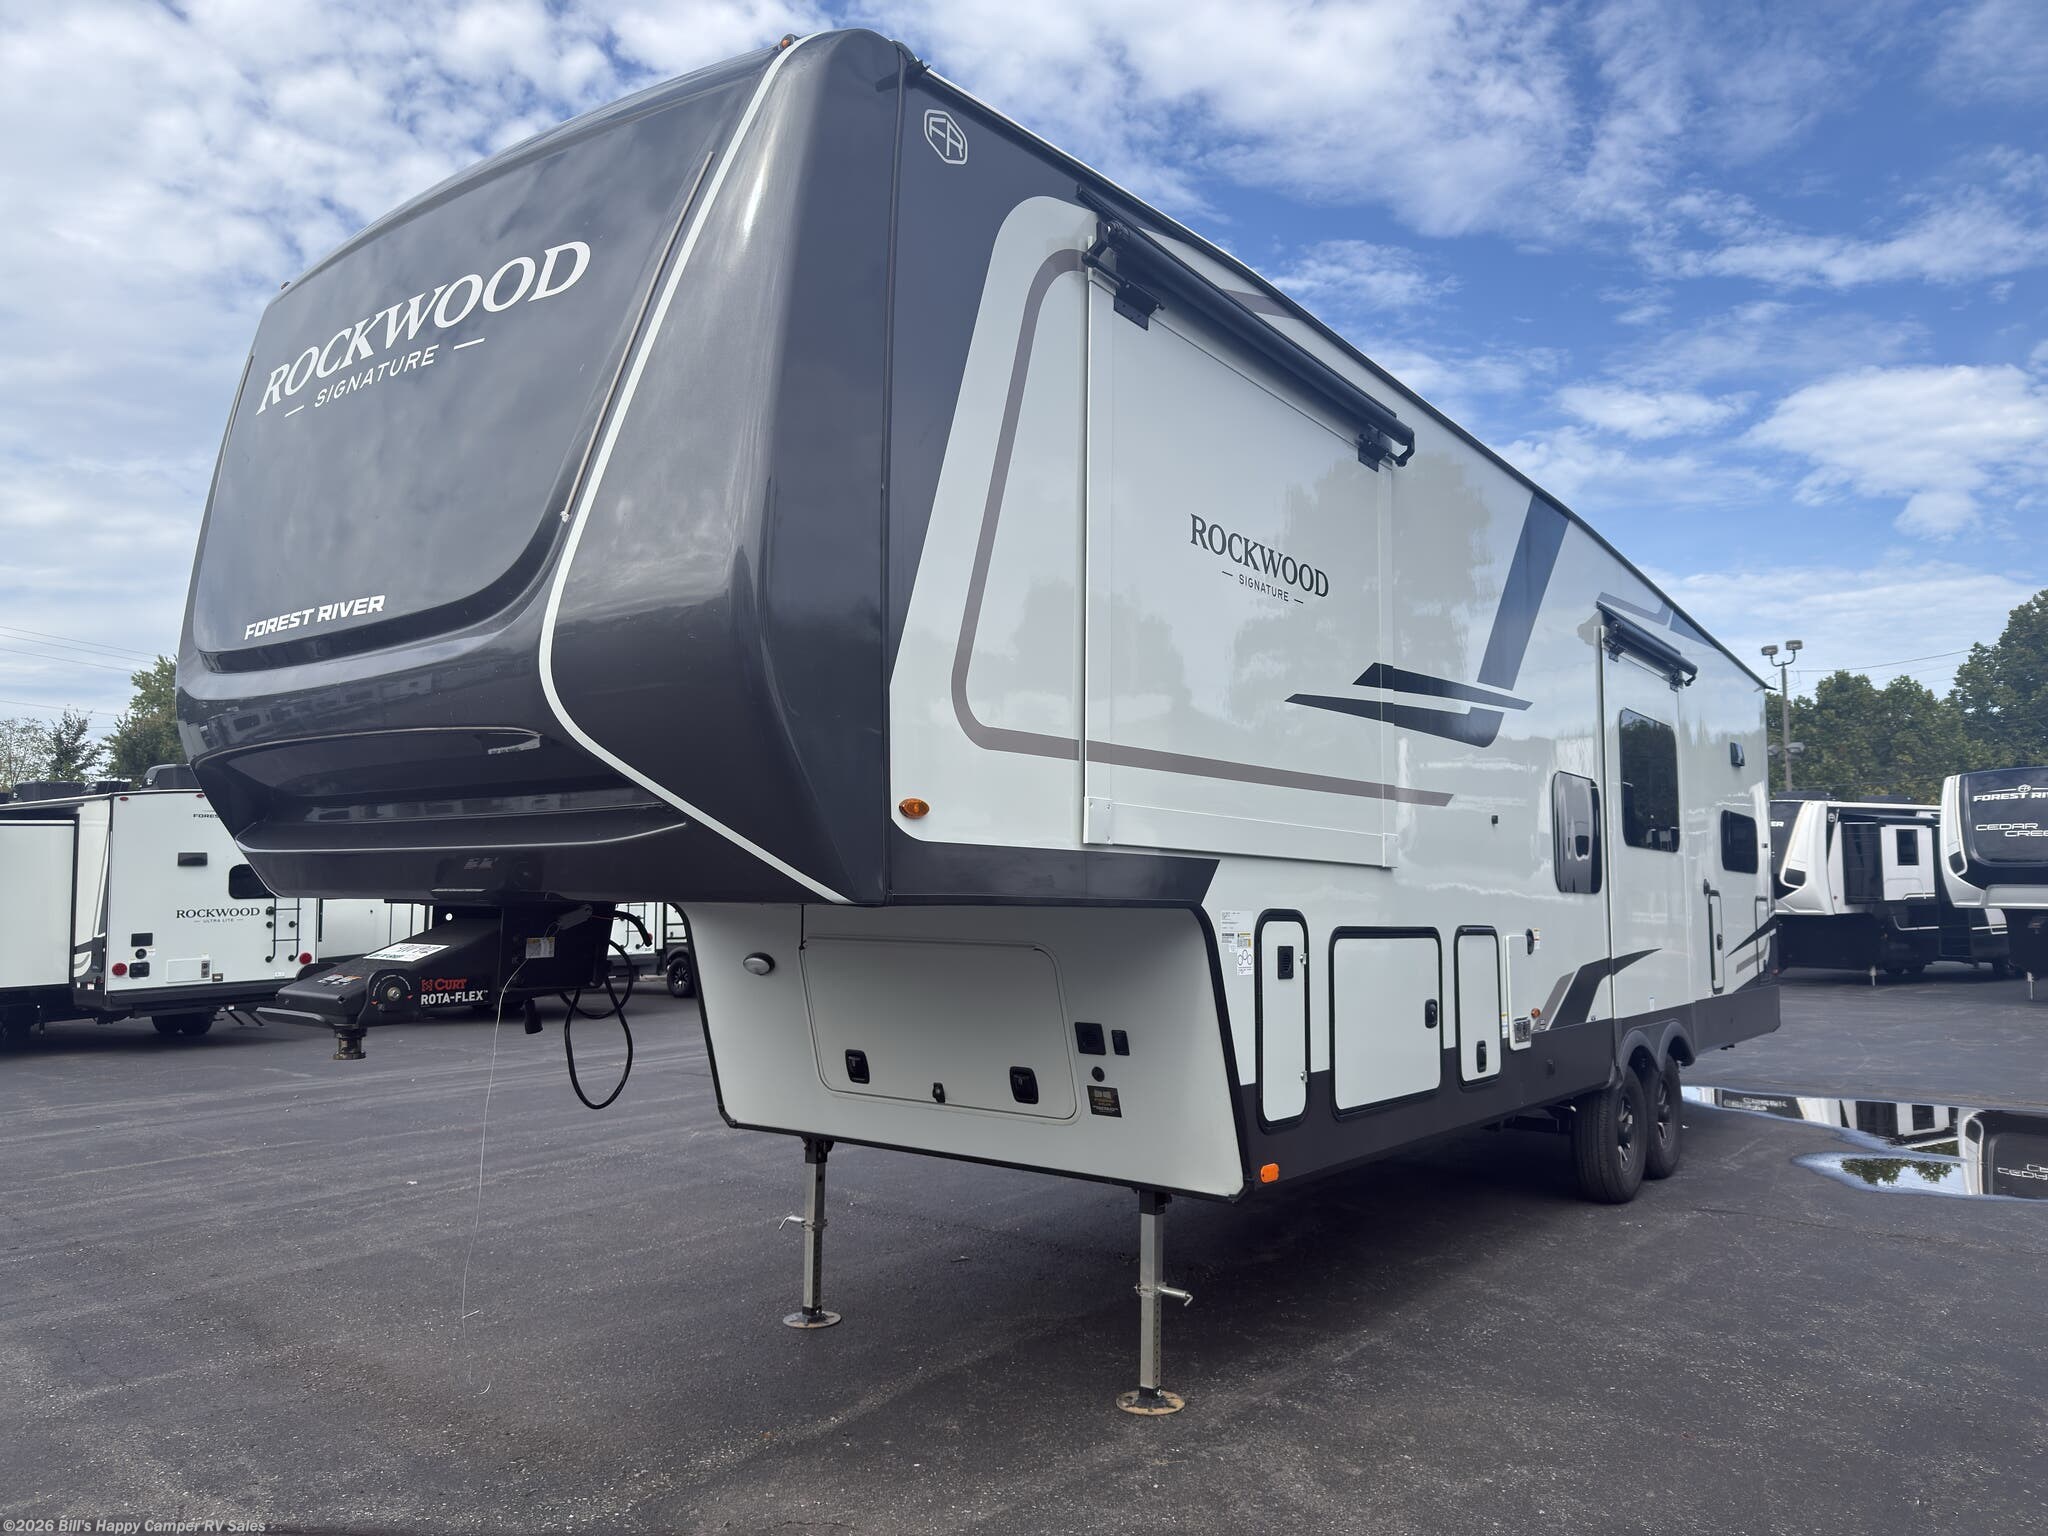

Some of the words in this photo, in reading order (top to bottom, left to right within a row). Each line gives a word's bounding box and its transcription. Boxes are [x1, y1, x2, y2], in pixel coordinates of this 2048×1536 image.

[256, 241, 591, 416] ROCKWOOD
[314, 343, 440, 408] SIGNATURE
[1190, 512, 1329, 598] ROCKWOOD
[1238, 573, 1289, 602] SIGNATURE
[244, 607, 315, 640] FOREST
[316, 594, 386, 623] RIVER
[1973, 792, 2029, 802] FOREST
[2031, 791, 2048, 799] RI
[1976, 822, 2039, 831] CEDAR
[176, 907, 260, 919] ROCKWOOD
[434, 978, 468, 990] CURT
